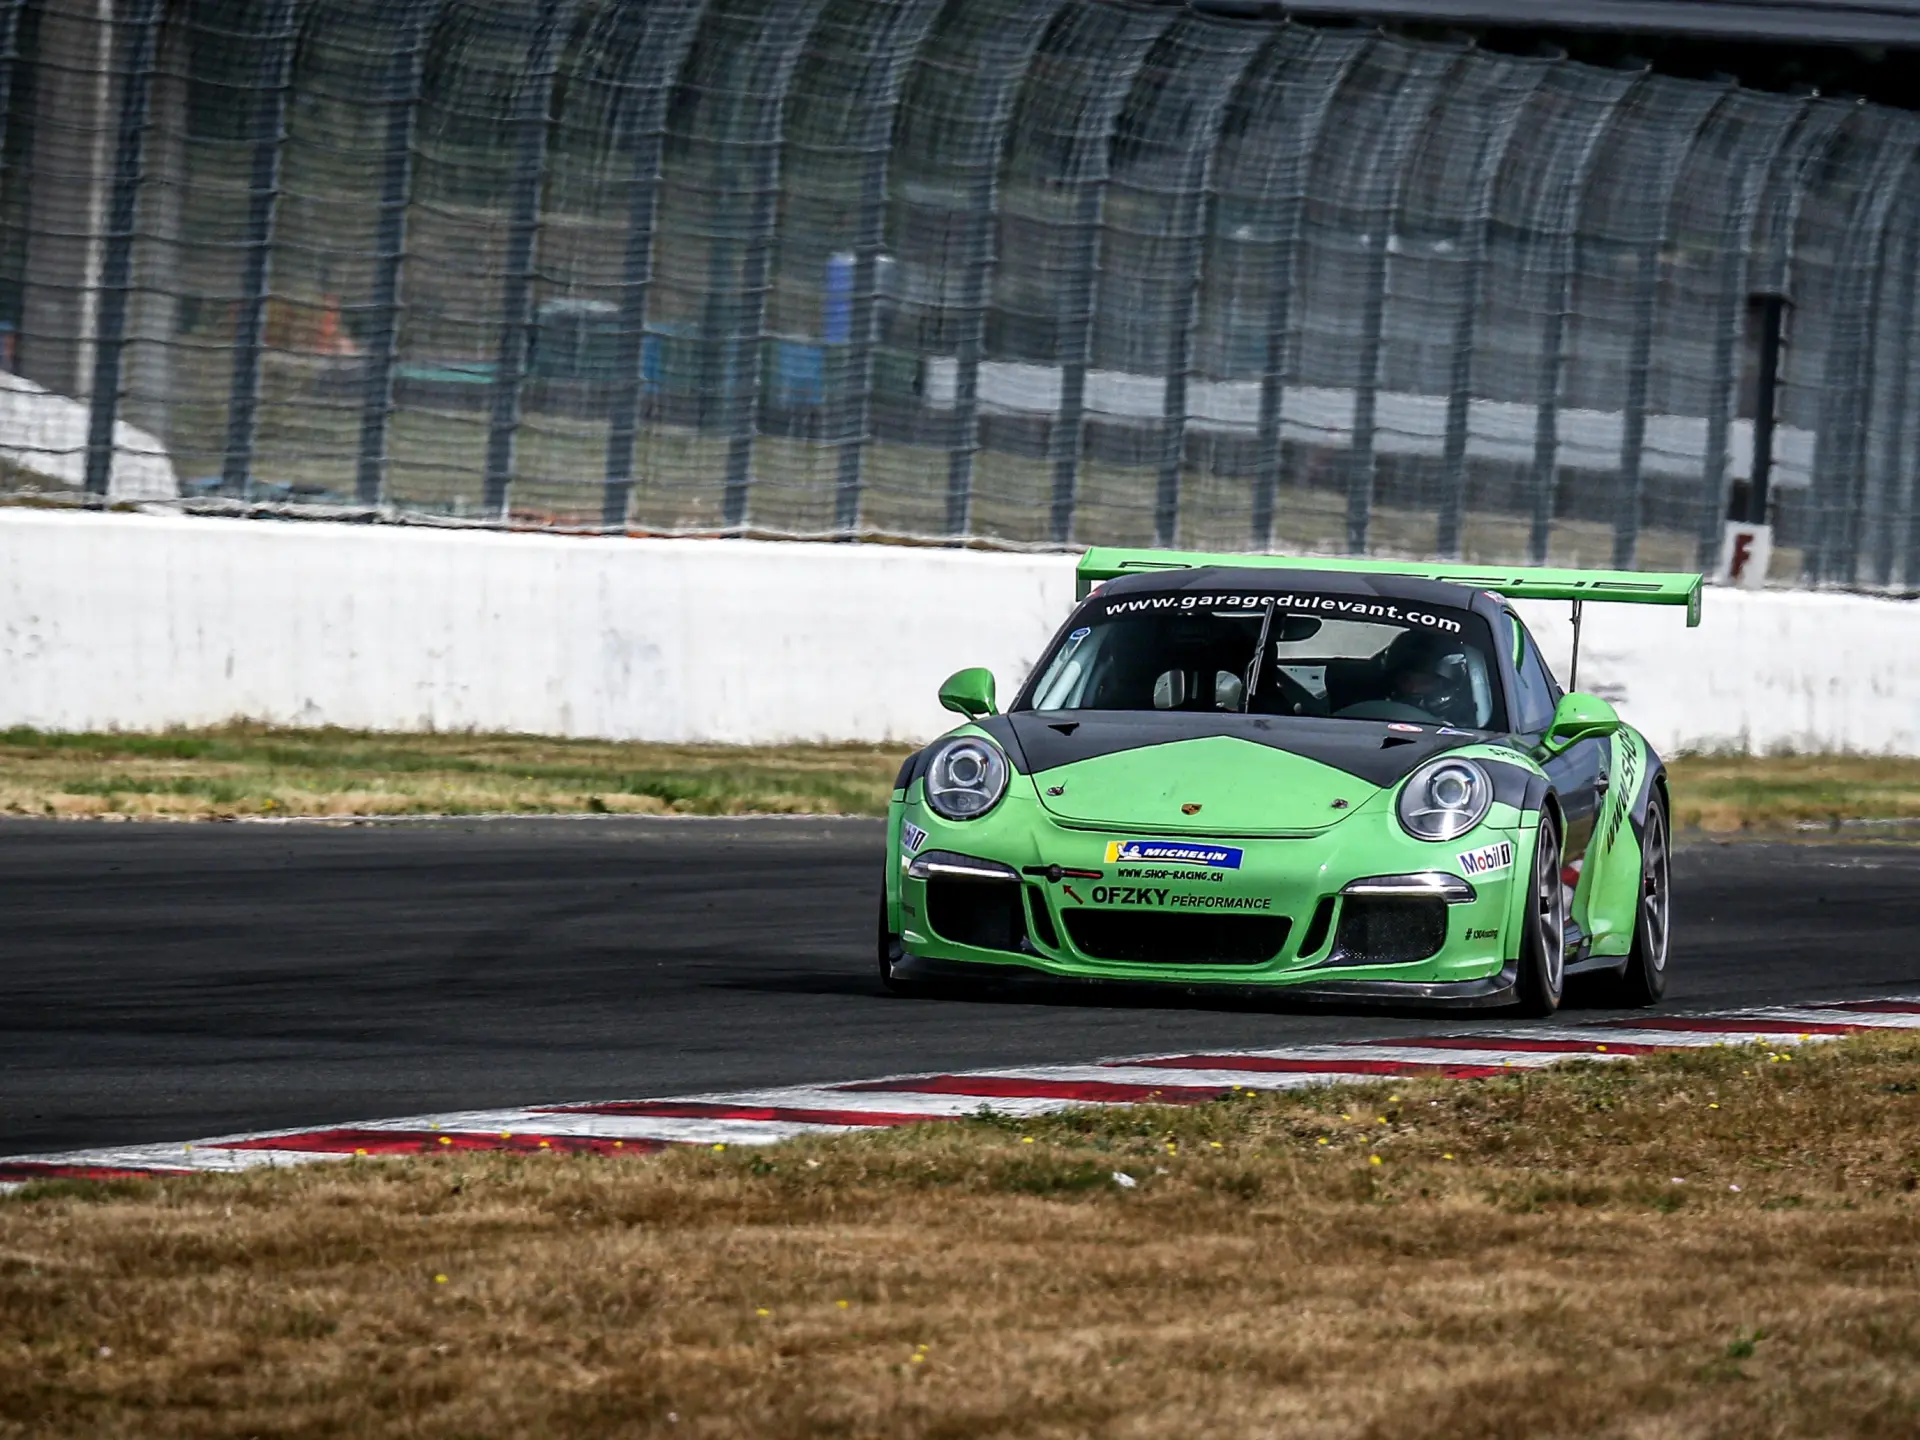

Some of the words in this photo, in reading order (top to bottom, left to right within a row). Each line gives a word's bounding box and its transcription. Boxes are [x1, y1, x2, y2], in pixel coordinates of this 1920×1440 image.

[1729, 532, 1755, 579] F
[1105, 594, 1462, 633] www.garagedulevant.com
[1143, 846, 1228, 861] MICHELIN
[1460, 846, 1500, 874] Mobil
[1500, 843, 1511, 866] 1
[1117, 868, 1224, 883] WWW.SHOP-RACING.CH
[1091, 886, 1171, 906] OFZKY
[1170, 895, 1272, 910] PERFORMANCE
